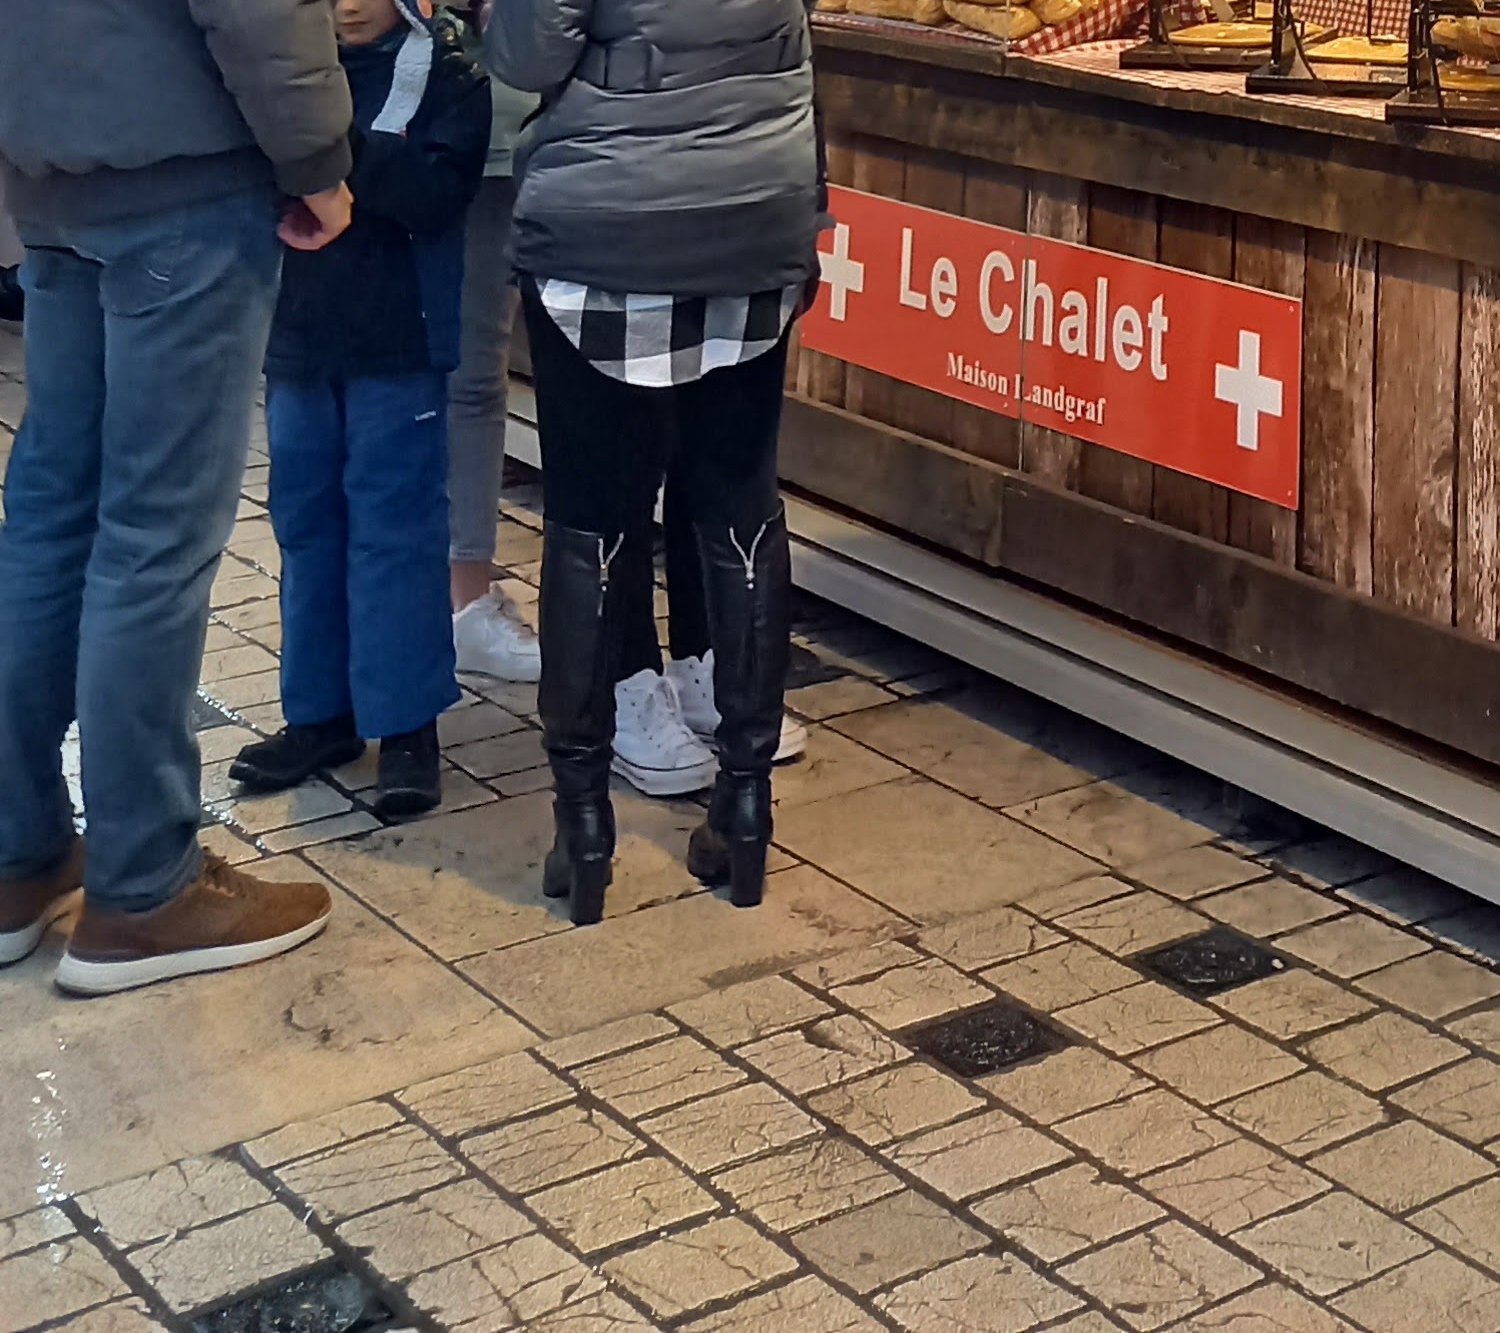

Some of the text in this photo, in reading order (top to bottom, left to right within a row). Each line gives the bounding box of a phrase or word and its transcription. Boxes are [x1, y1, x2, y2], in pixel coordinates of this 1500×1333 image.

[899, 227, 1168, 381] Le Chalet
[946, 352, 1107, 426] Maison Landgraf
